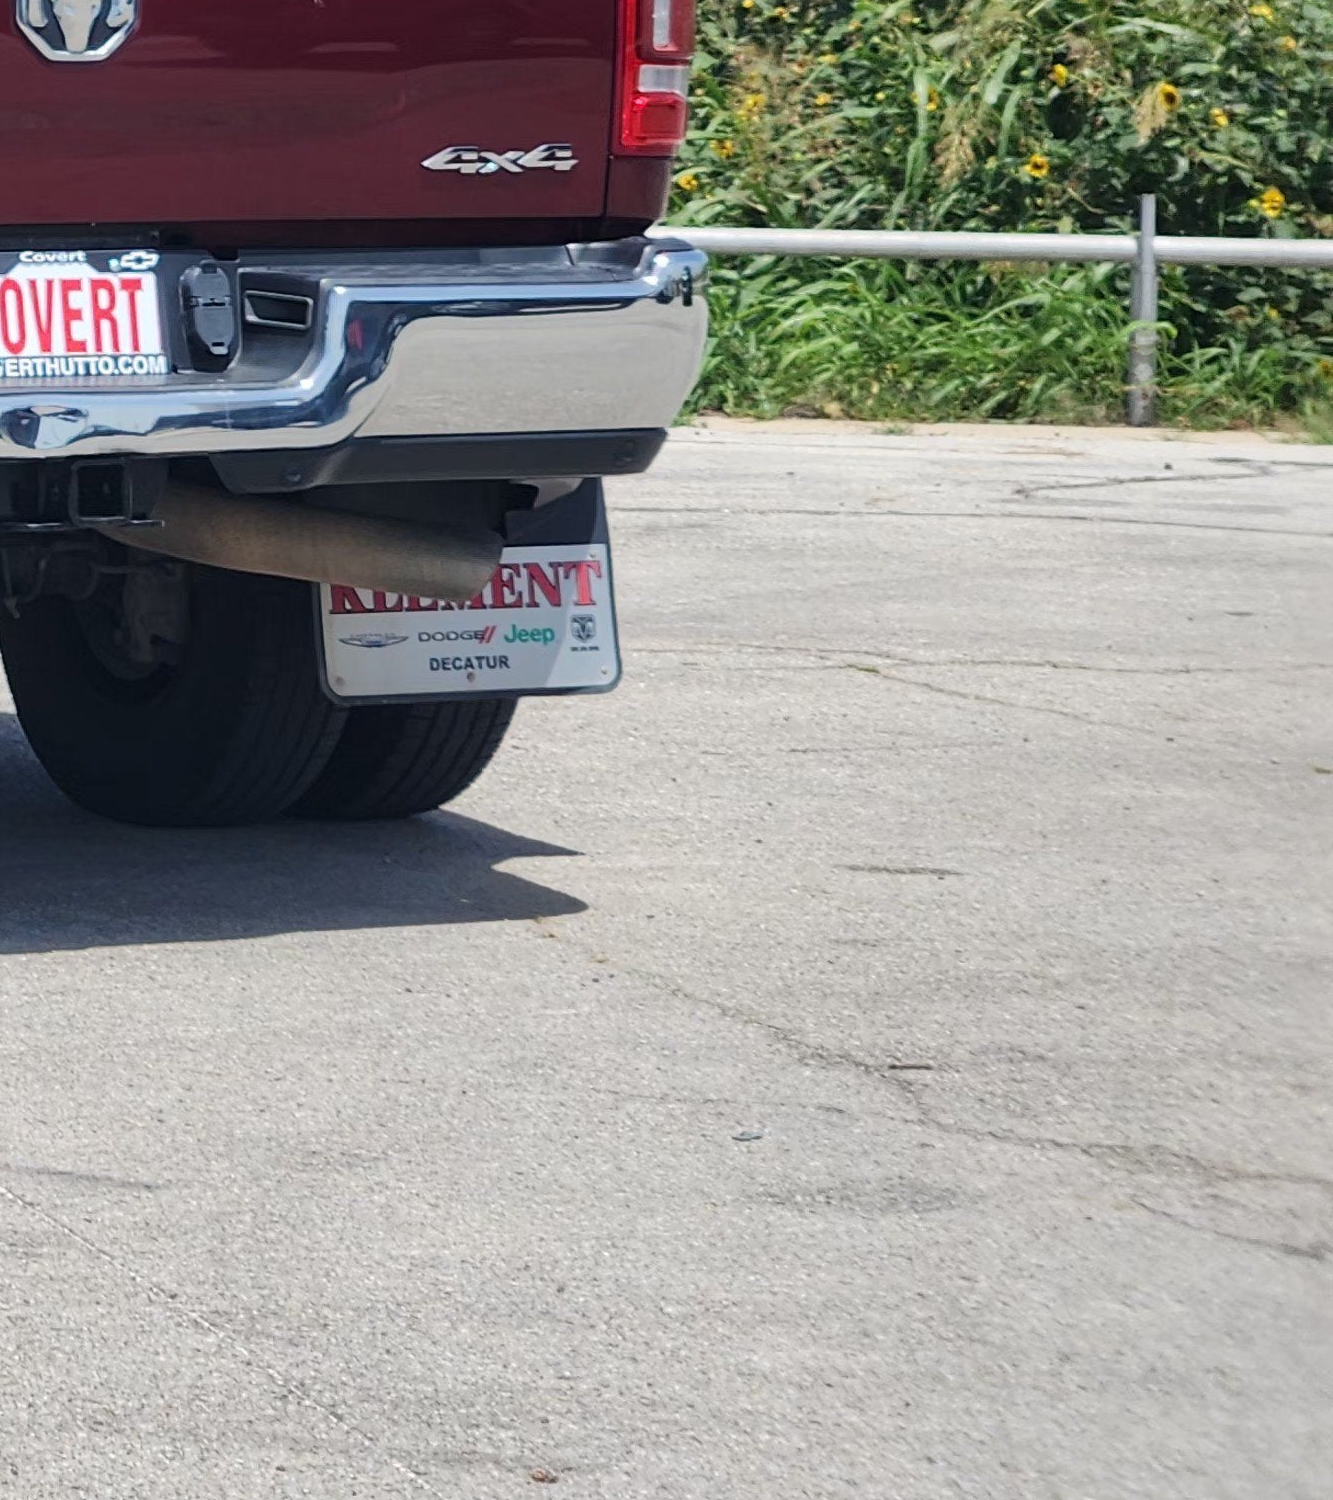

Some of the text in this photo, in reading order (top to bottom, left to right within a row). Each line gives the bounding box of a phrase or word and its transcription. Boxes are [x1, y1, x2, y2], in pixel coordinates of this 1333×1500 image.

[420, 143, 580, 175] 4x4
[18, 249, 88, 264] Covert
[418, 629, 486, 643] DODGE
[503, 623, 555, 646] Jeep
[428, 655, 511, 672] DECATUR
